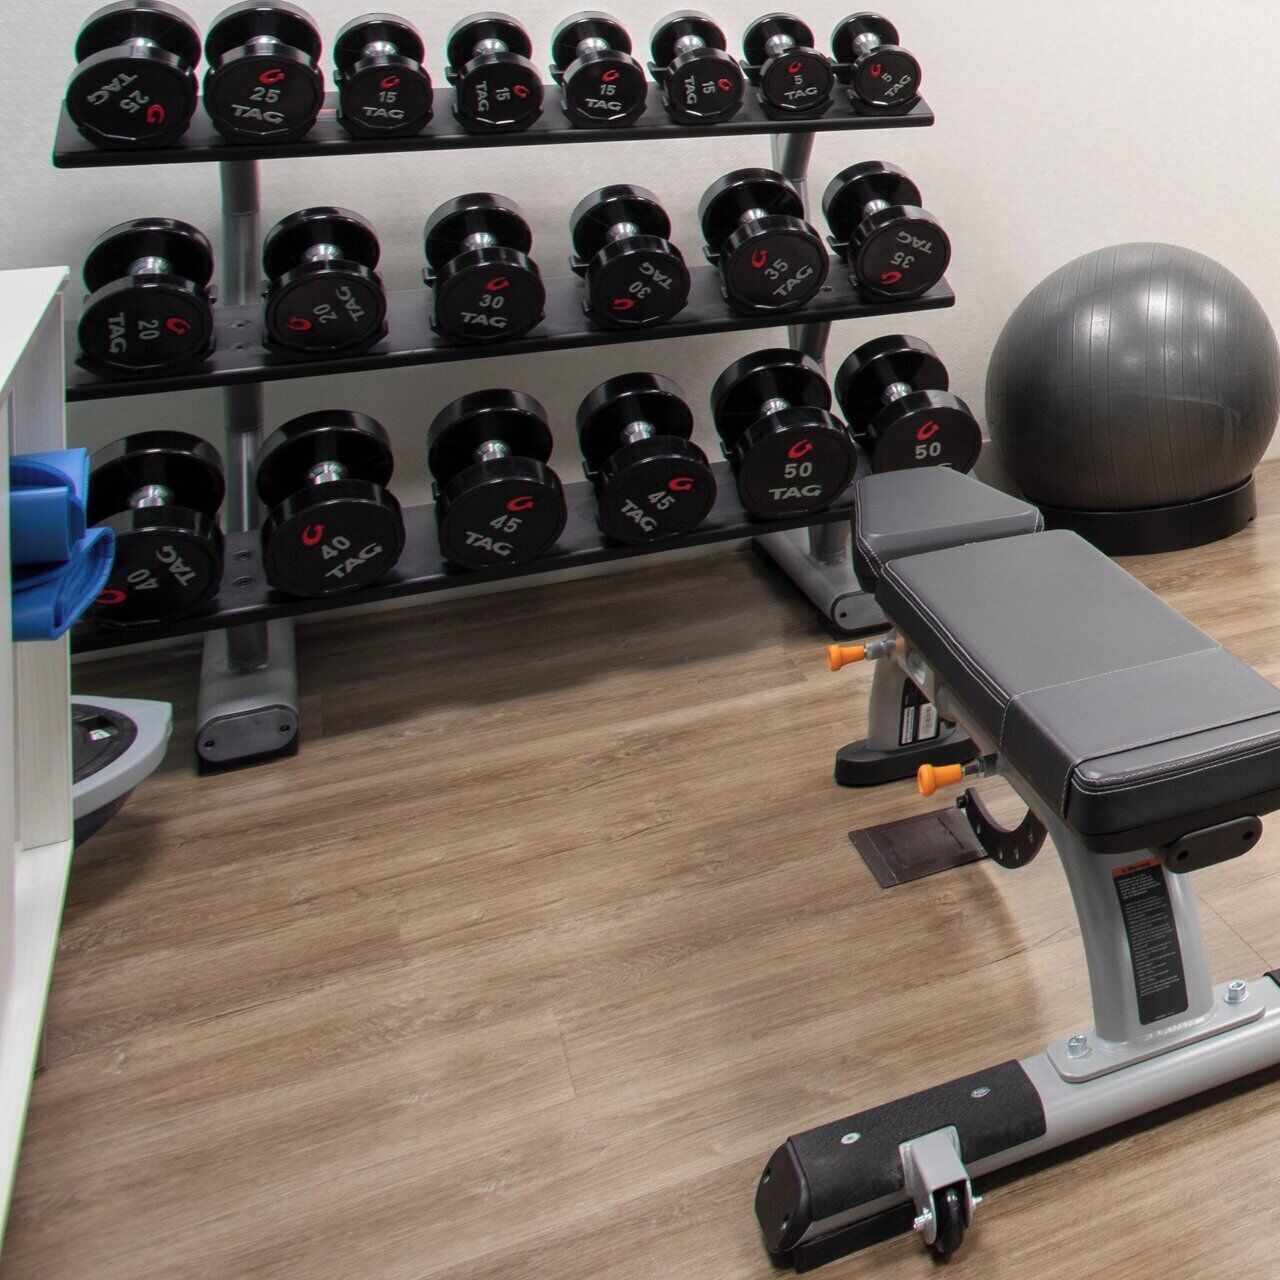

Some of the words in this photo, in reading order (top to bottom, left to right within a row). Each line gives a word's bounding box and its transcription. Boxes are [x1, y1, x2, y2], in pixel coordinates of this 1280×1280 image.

[702, 80, 715, 94] 15
[794, 74, 803, 85] 5
[881, 72, 893, 83] 5
[884, 74, 912, 97] TAG
[87, 73, 138, 106] TAG
[250, 86, 281, 104] 25
[378, 91, 397, 103] 15
[475, 80, 490, 112] TAG
[496, 87, 510, 101] 15
[600, 84, 617, 96] 15
[684, 76, 697, 104] TAG
[784, 86, 818, 100] TAG
[119, 89, 149, 113] 25
[585, 98, 623, 111] TAG
[231, 104, 285, 125] TAG
[362, 106, 405, 119] TAG
[895, 230, 934, 254] TAG
[764, 257, 790, 280] 35
[891, 251, 915, 269] 35
[639, 261, 674, 290] TAG
[772, 263, 814, 298] TAG
[628, 280, 651, 299] 30
[335, 286, 368, 322] TAG
[479, 294, 504, 309] 30
[312, 303, 339, 323] 20
[460, 312, 508, 328] TAG
[108, 312, 127, 353] TAG
[138, 319, 160, 340] 20
[914, 441, 942, 460] 50
[783, 462, 813, 479] 50
[647, 491, 676, 510] 45
[768, 484, 822, 501] TAG
[489, 514, 522, 533] 45
[620, 499, 658, 532] TAG
[321, 536, 351, 560] 40
[465, 531, 514, 556] TAG
[156, 544, 197, 586] TAG
[324, 542, 383, 580] TAG
[126, 569, 160, 590] 40
